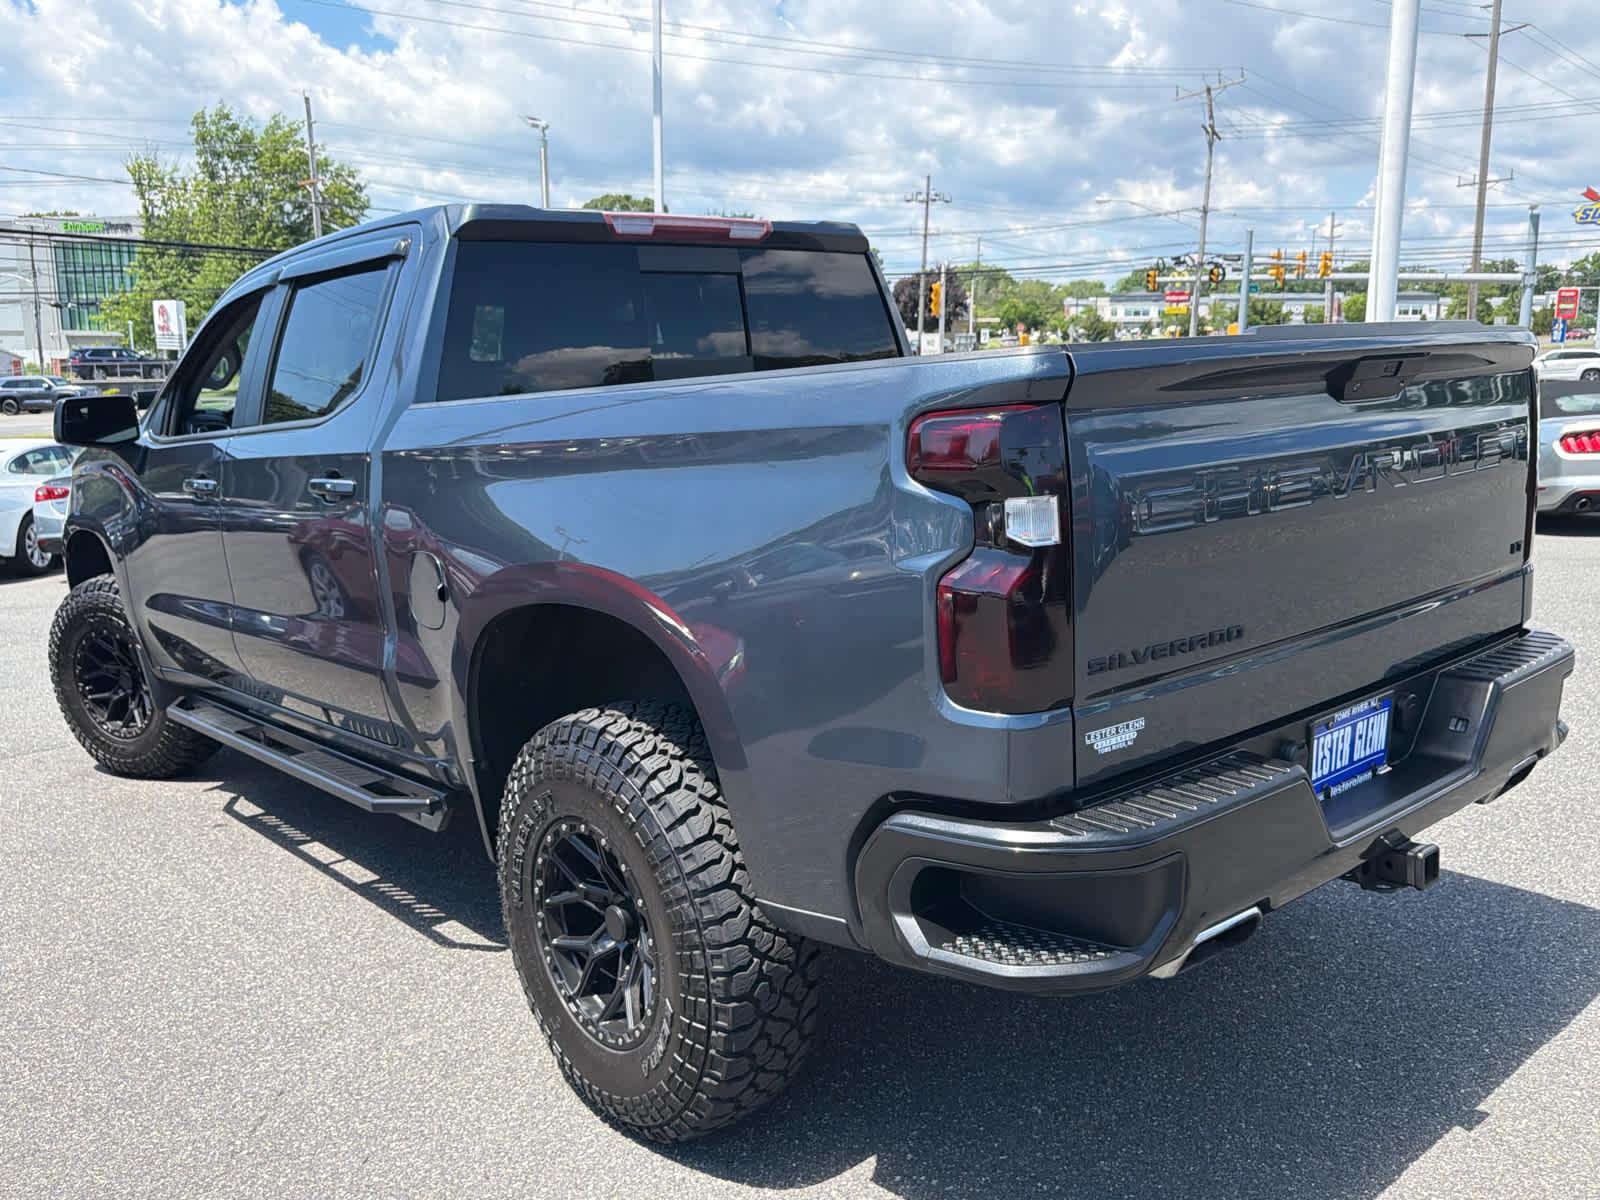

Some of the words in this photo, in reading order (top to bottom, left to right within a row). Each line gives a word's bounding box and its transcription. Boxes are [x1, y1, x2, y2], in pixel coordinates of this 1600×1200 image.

[1130, 422, 1528, 535] CHEVROLET
[1087, 624, 1244, 676] SILVERADO
[1085, 727, 1117, 744] LESTER
[1118, 718, 1145, 733] GLENN
[1312, 726, 1352, 781] LESTER
[1353, 711, 1389, 762] GLENN
